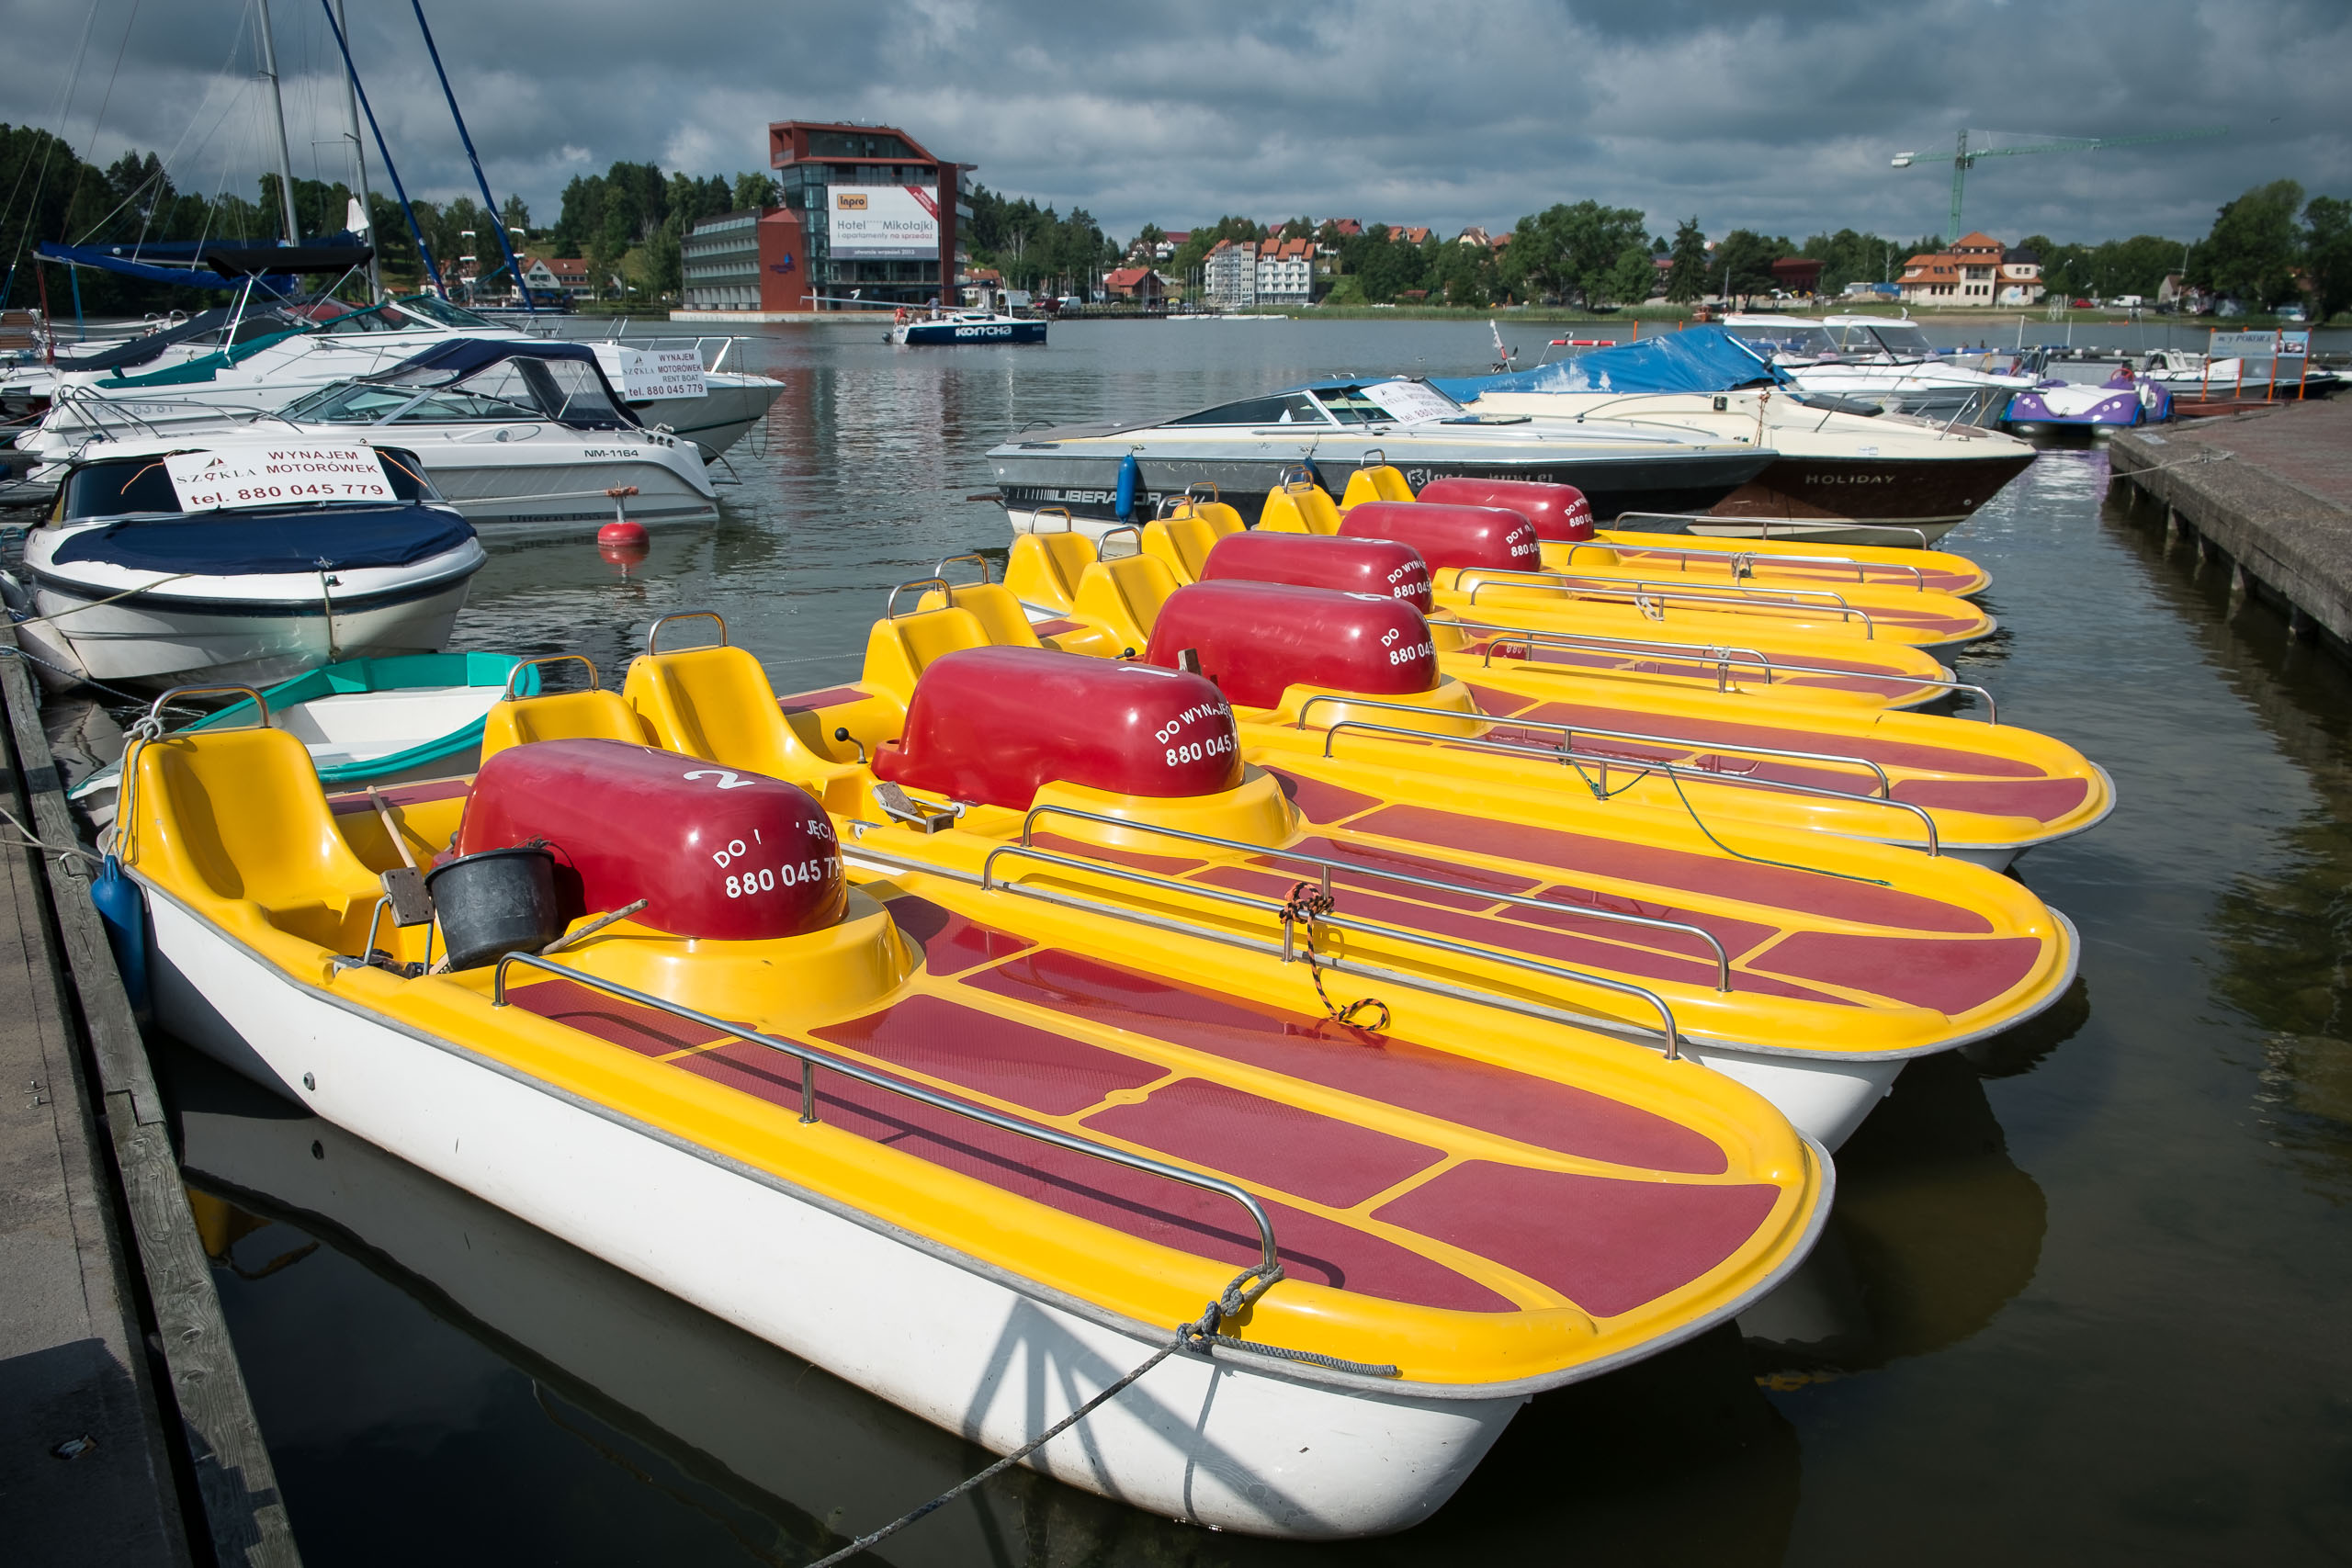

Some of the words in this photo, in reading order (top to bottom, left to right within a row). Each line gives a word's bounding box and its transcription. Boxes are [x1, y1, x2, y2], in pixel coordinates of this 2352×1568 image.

[837, 220, 866, 230] Hotel
[882, 220, 933, 231] Mikołajki
[659, 353, 695, 362] WYNAJEM
[657, 364, 703, 373] MOTORÓWEK
[628, 387, 644, 397] tel.
[647, 386, 664, 395] 880
[667, 385, 684, 394] 045
[686, 384, 704, 393] 779
[267, 450, 359, 460] WYNAJEM
[584, 449, 639, 457] NM-1164
[266, 461, 379, 474] MOTORÓWEK
[1805, 474, 1896, 484] HOLIDAY
[190, 492, 230, 505] tel.
[237, 486, 282, 501] 880
[290, 484, 334, 495] 045
[341, 484, 384, 495] 779
[1056, 490, 1162, 506] LIBERAOR
[1565, 504, 1576, 516] DO
[1569, 515, 1584, 527] 880
[1506, 531, 1519, 544] DO
[1511, 541, 1529, 557] 880
[1387, 569, 1403, 584] DO
[1394, 583, 1416, 598] 880
[1381, 628, 1399, 648] DO
[1390, 643, 1416, 665] 880
[1155, 720, 1180, 744] DO
[1165, 742, 1203, 767] 880
[1205, 735, 1231, 756] 045
[684, 770, 755, 789] 2
[713, 840, 746, 869] DO
[726, 869, 775, 898] 880
[782, 860, 821, 886] 045
